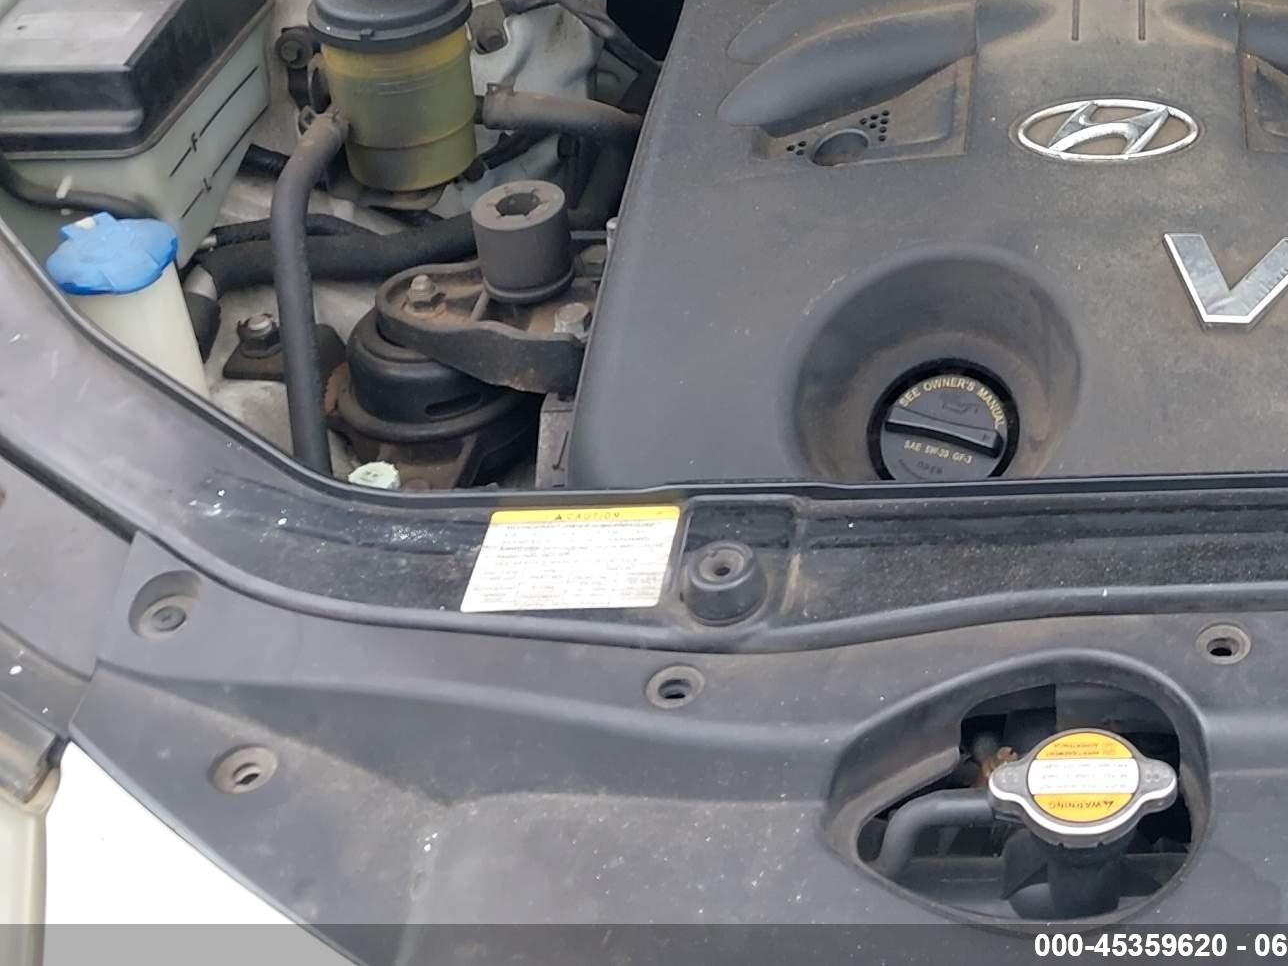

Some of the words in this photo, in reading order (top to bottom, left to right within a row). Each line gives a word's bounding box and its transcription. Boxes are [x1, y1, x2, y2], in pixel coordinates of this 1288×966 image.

[899, 386, 921, 407] SEE
[922, 376, 976, 393] OWNER'S
[976, 387, 1006, 431] MANUAL
[903, 439, 923, 453] SAE
[566, 511, 620, 522] CAUTION
[1048, 800, 1102, 810] WARNING
